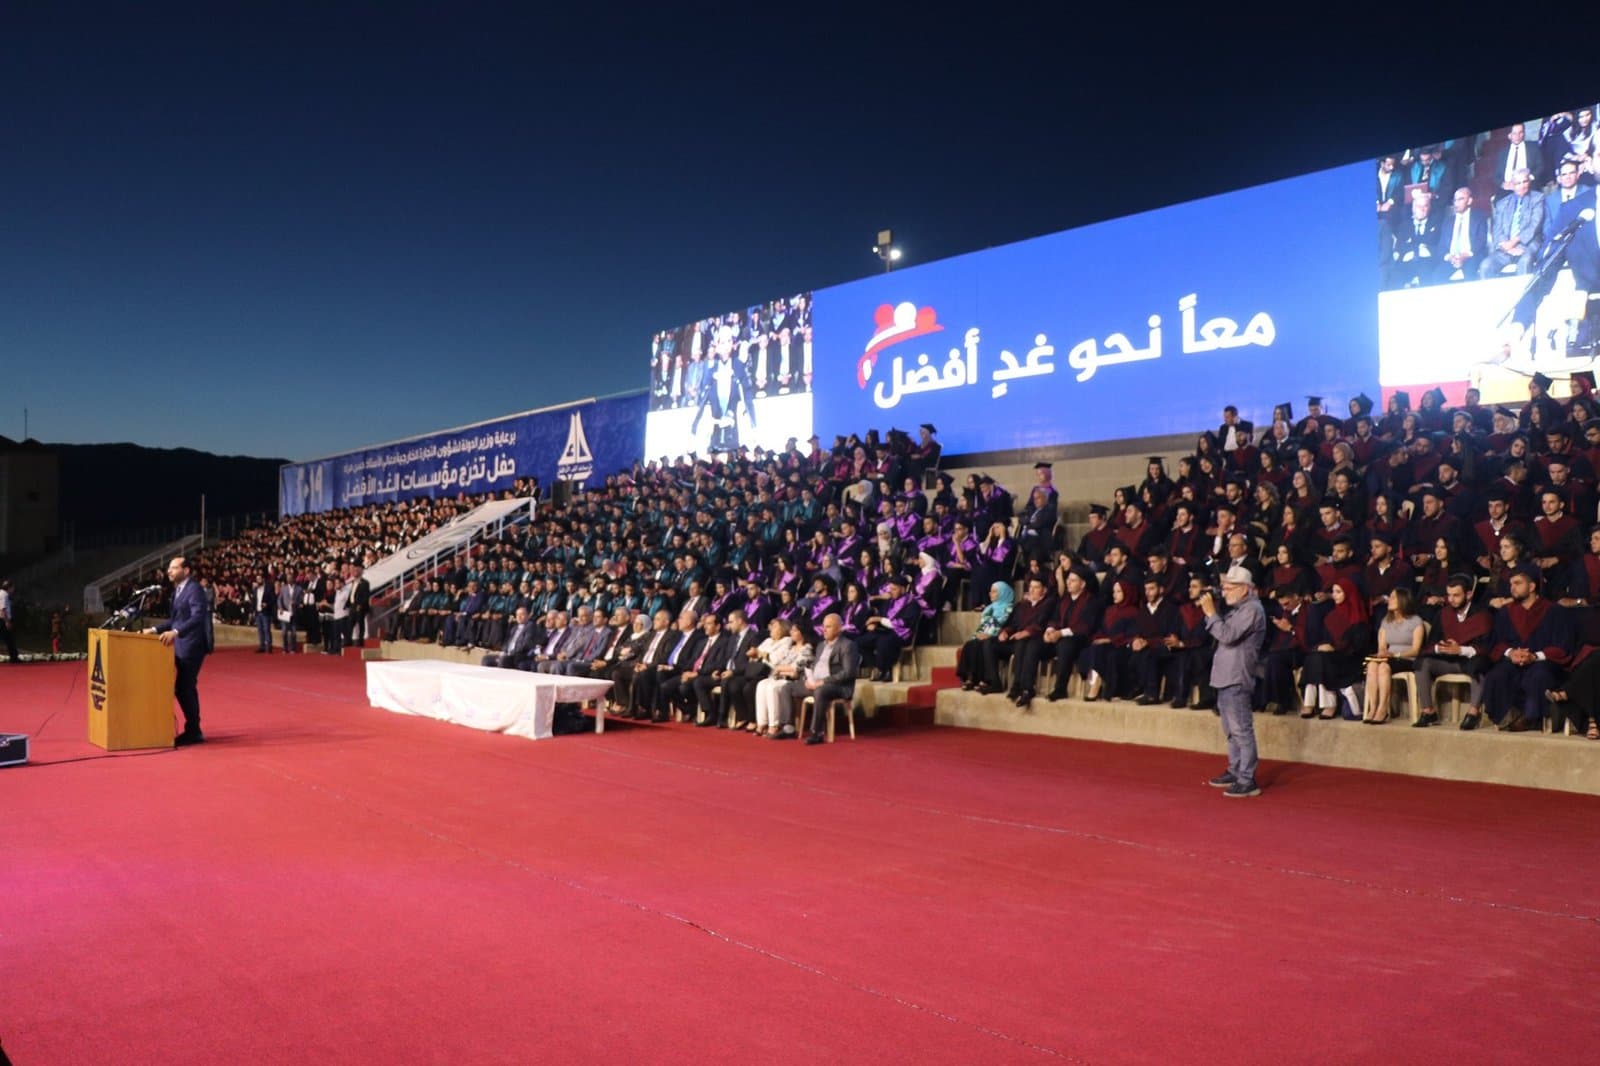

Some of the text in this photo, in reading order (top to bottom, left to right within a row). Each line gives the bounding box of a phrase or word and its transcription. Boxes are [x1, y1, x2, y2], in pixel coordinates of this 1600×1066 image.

[1068, 314, 1161, 383] نحو
[873, 327, 980, 409] أفضل
[478, 433, 494, 450] وزير
[494, 431, 516, 447] برعاية
[401, 460, 458, 490] مؤسسات
[487, 452, 516, 483] حفل
[376, 472, 400, 494] الغد
